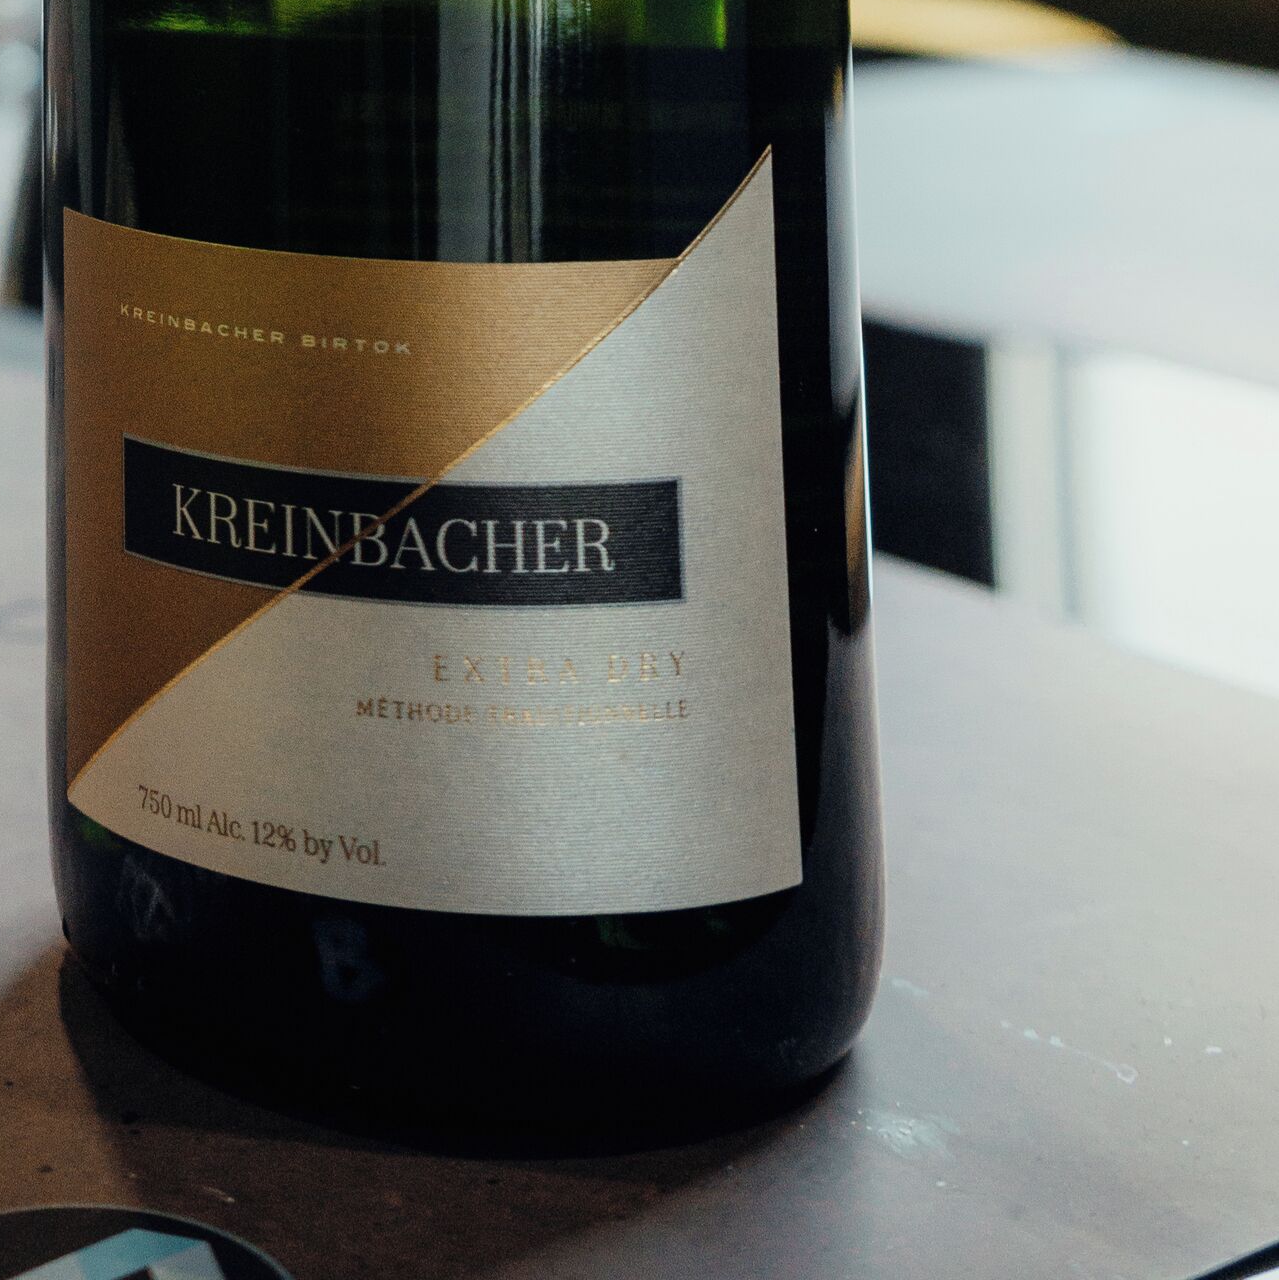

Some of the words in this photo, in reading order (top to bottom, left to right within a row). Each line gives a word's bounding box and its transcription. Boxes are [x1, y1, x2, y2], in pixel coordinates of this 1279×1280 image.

[119, 303, 285, 345] KREINBACHER
[299, 333, 412, 355] BIRTOK
[170, 482, 617, 574] KREINBACHER
[432, 653, 578, 685] EXTRA
[606, 649, 687, 683] DRY
[138, 784, 172, 819] 750
[176, 804, 202, 830] ml
[206, 809, 247, 841] Alc.
[251, 819, 298, 852] 12%
[301, 828, 334, 864] by
[337, 833, 388, 867] Vol.
